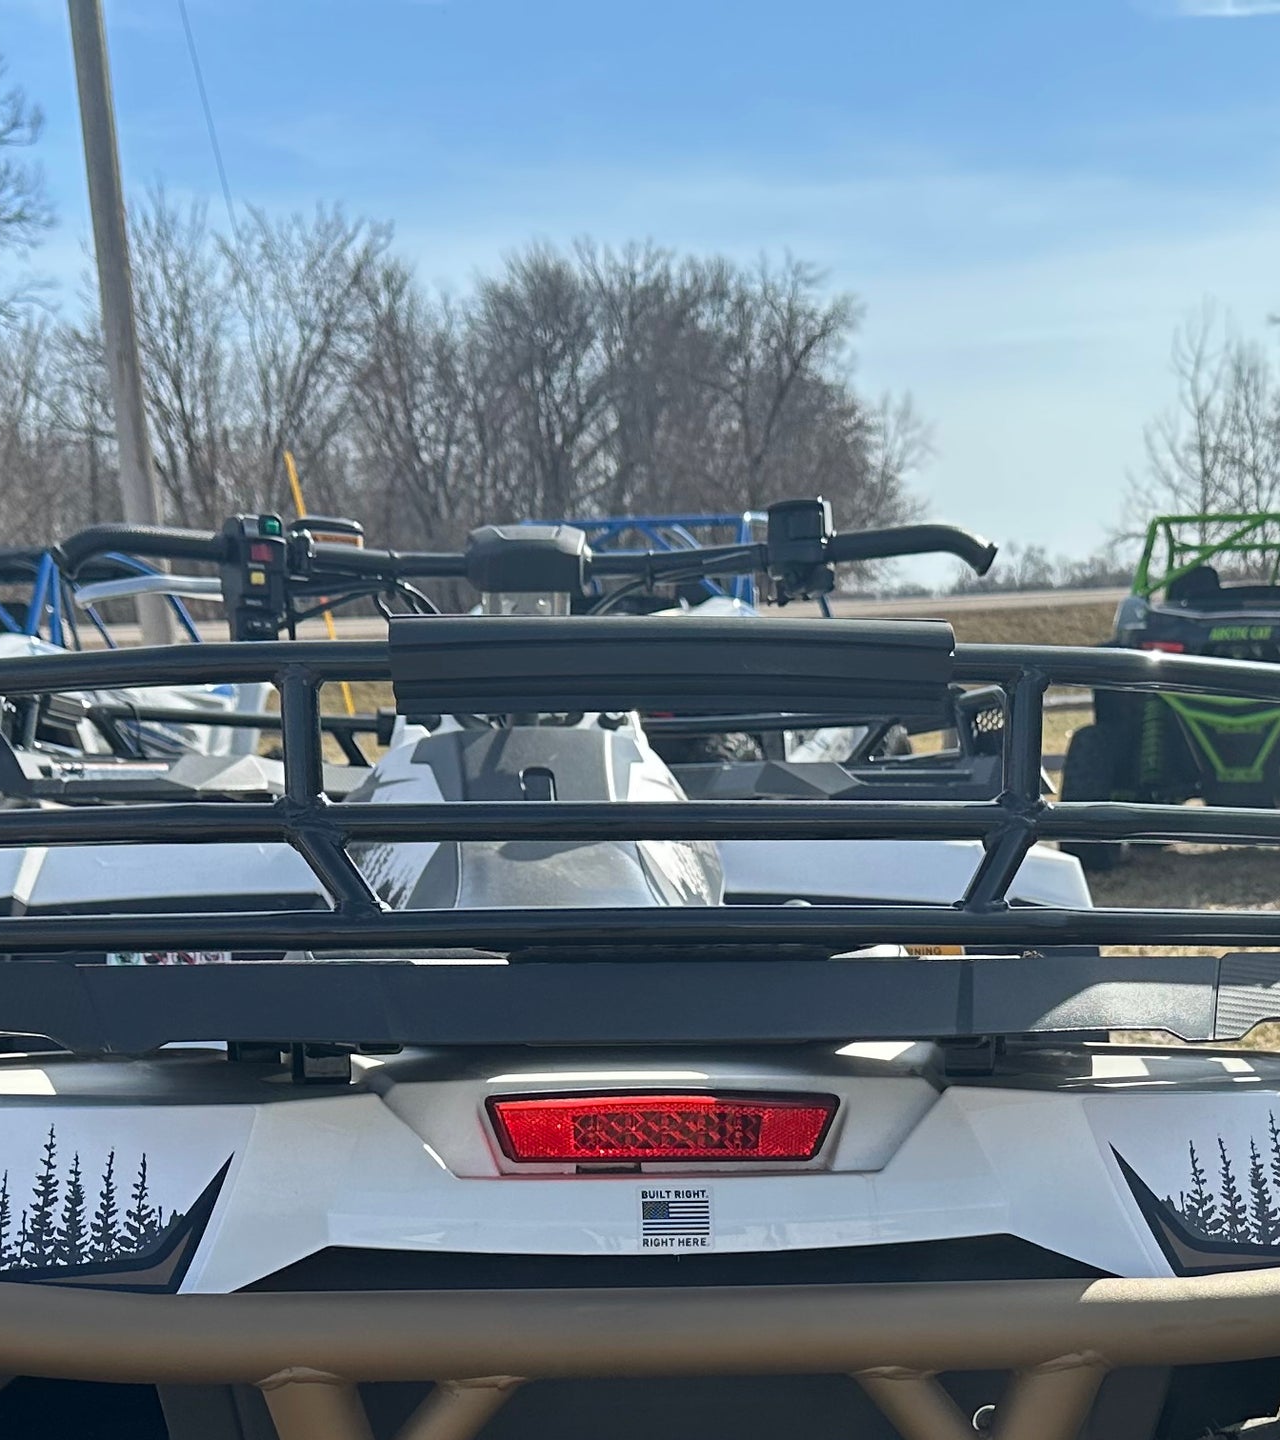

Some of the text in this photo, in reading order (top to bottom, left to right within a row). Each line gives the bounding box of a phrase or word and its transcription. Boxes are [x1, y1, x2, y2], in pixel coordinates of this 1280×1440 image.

[641, 1189, 709, 1199] BUILT RIGHT.
[642, 1237, 710, 1247] RIGHT HERE.
